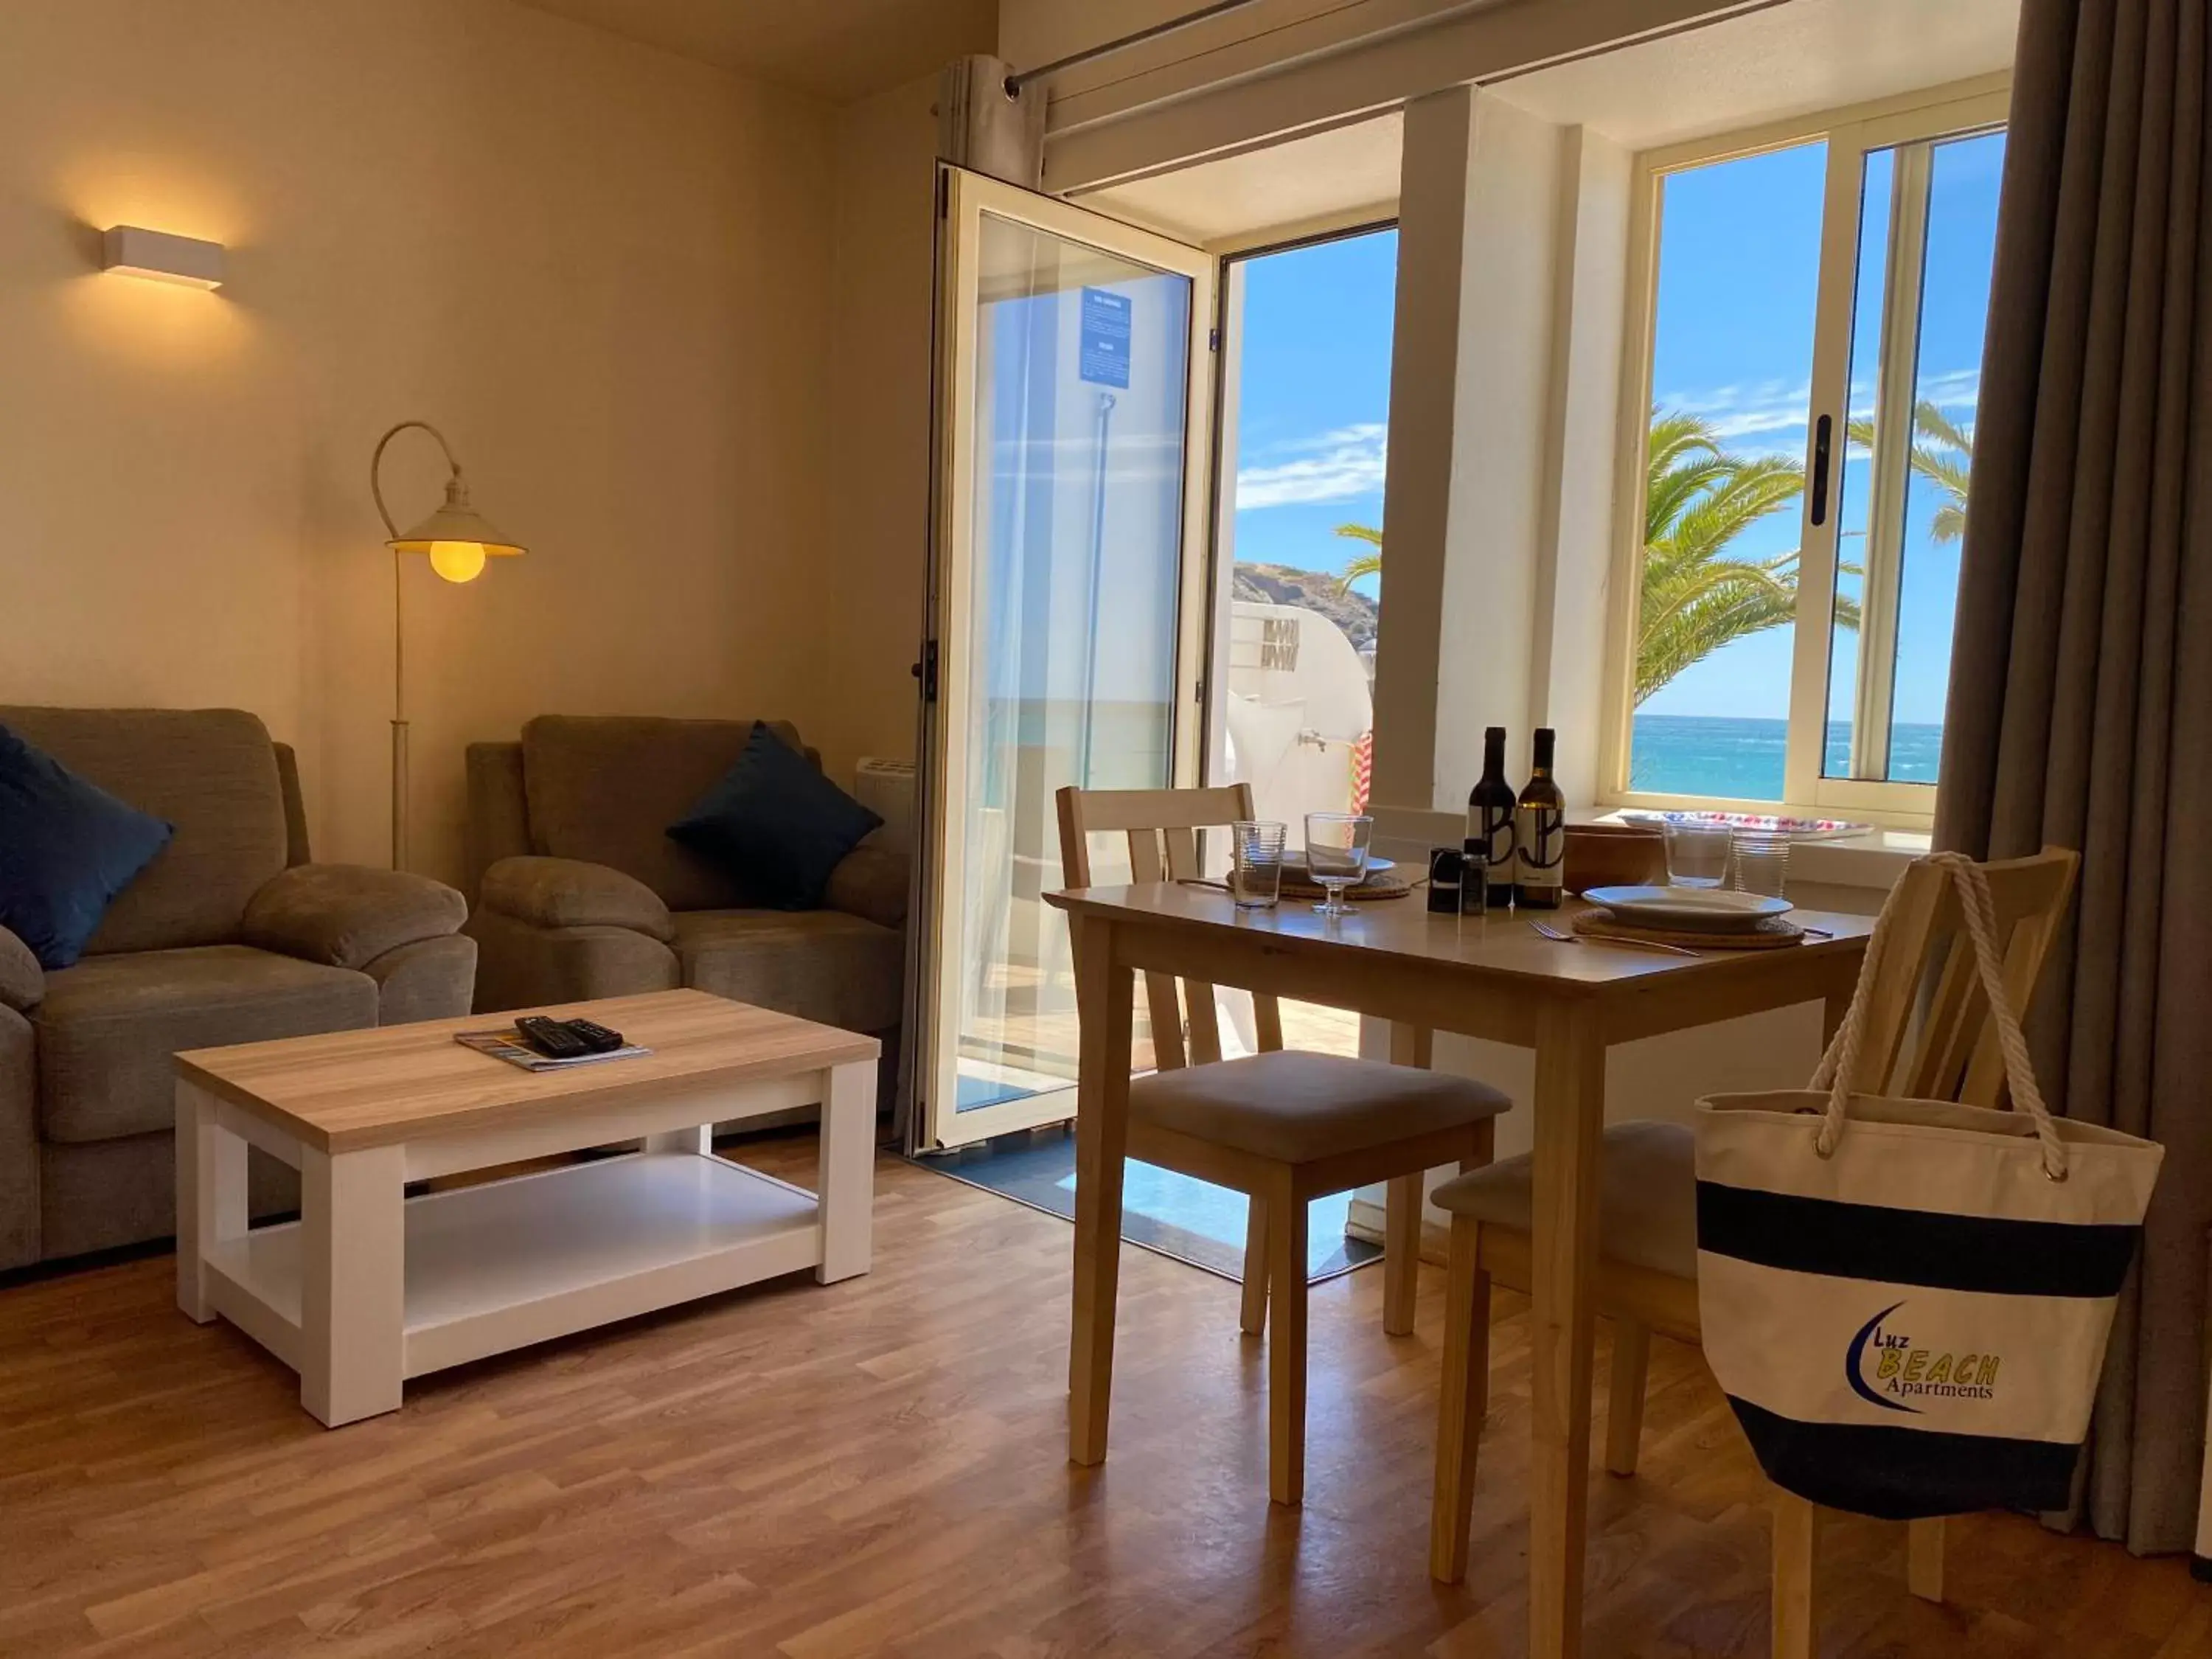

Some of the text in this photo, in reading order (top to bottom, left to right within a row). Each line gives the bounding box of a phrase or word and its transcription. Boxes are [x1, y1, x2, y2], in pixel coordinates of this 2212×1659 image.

[1874, 1326, 1910, 1349] Luz
[1877, 1349, 2000, 1385] BEACH
[1886, 1377, 1993, 1399] Apartments
